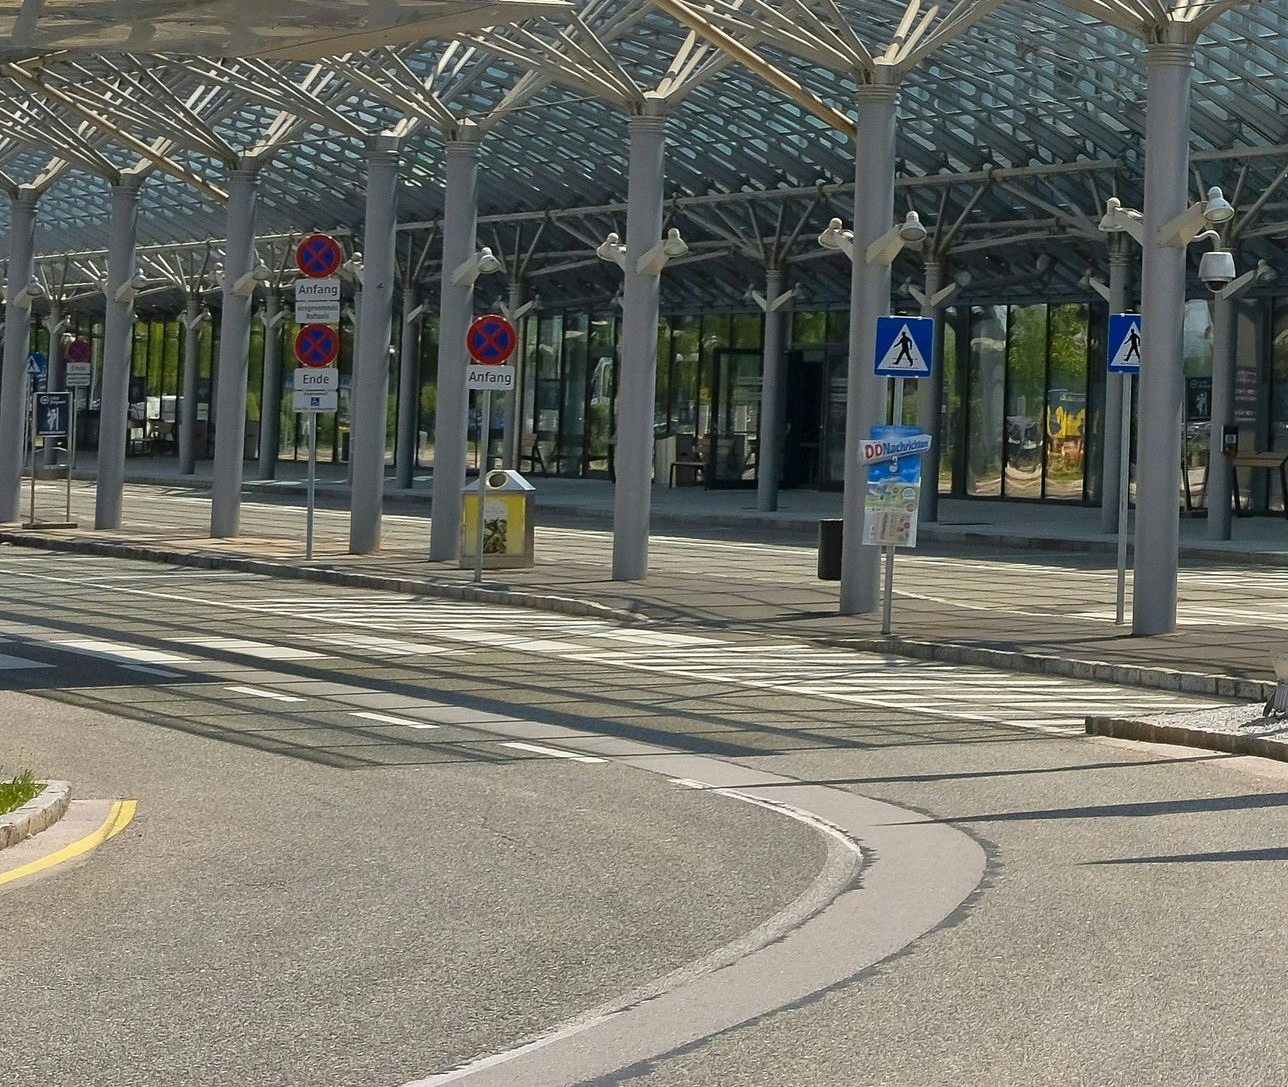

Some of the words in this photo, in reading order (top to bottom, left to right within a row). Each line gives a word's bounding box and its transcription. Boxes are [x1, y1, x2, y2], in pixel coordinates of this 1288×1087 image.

[298, 284, 338, 296] Anfang
[303, 374, 329, 384] Ende
[469, 371, 511, 385] Anfang
